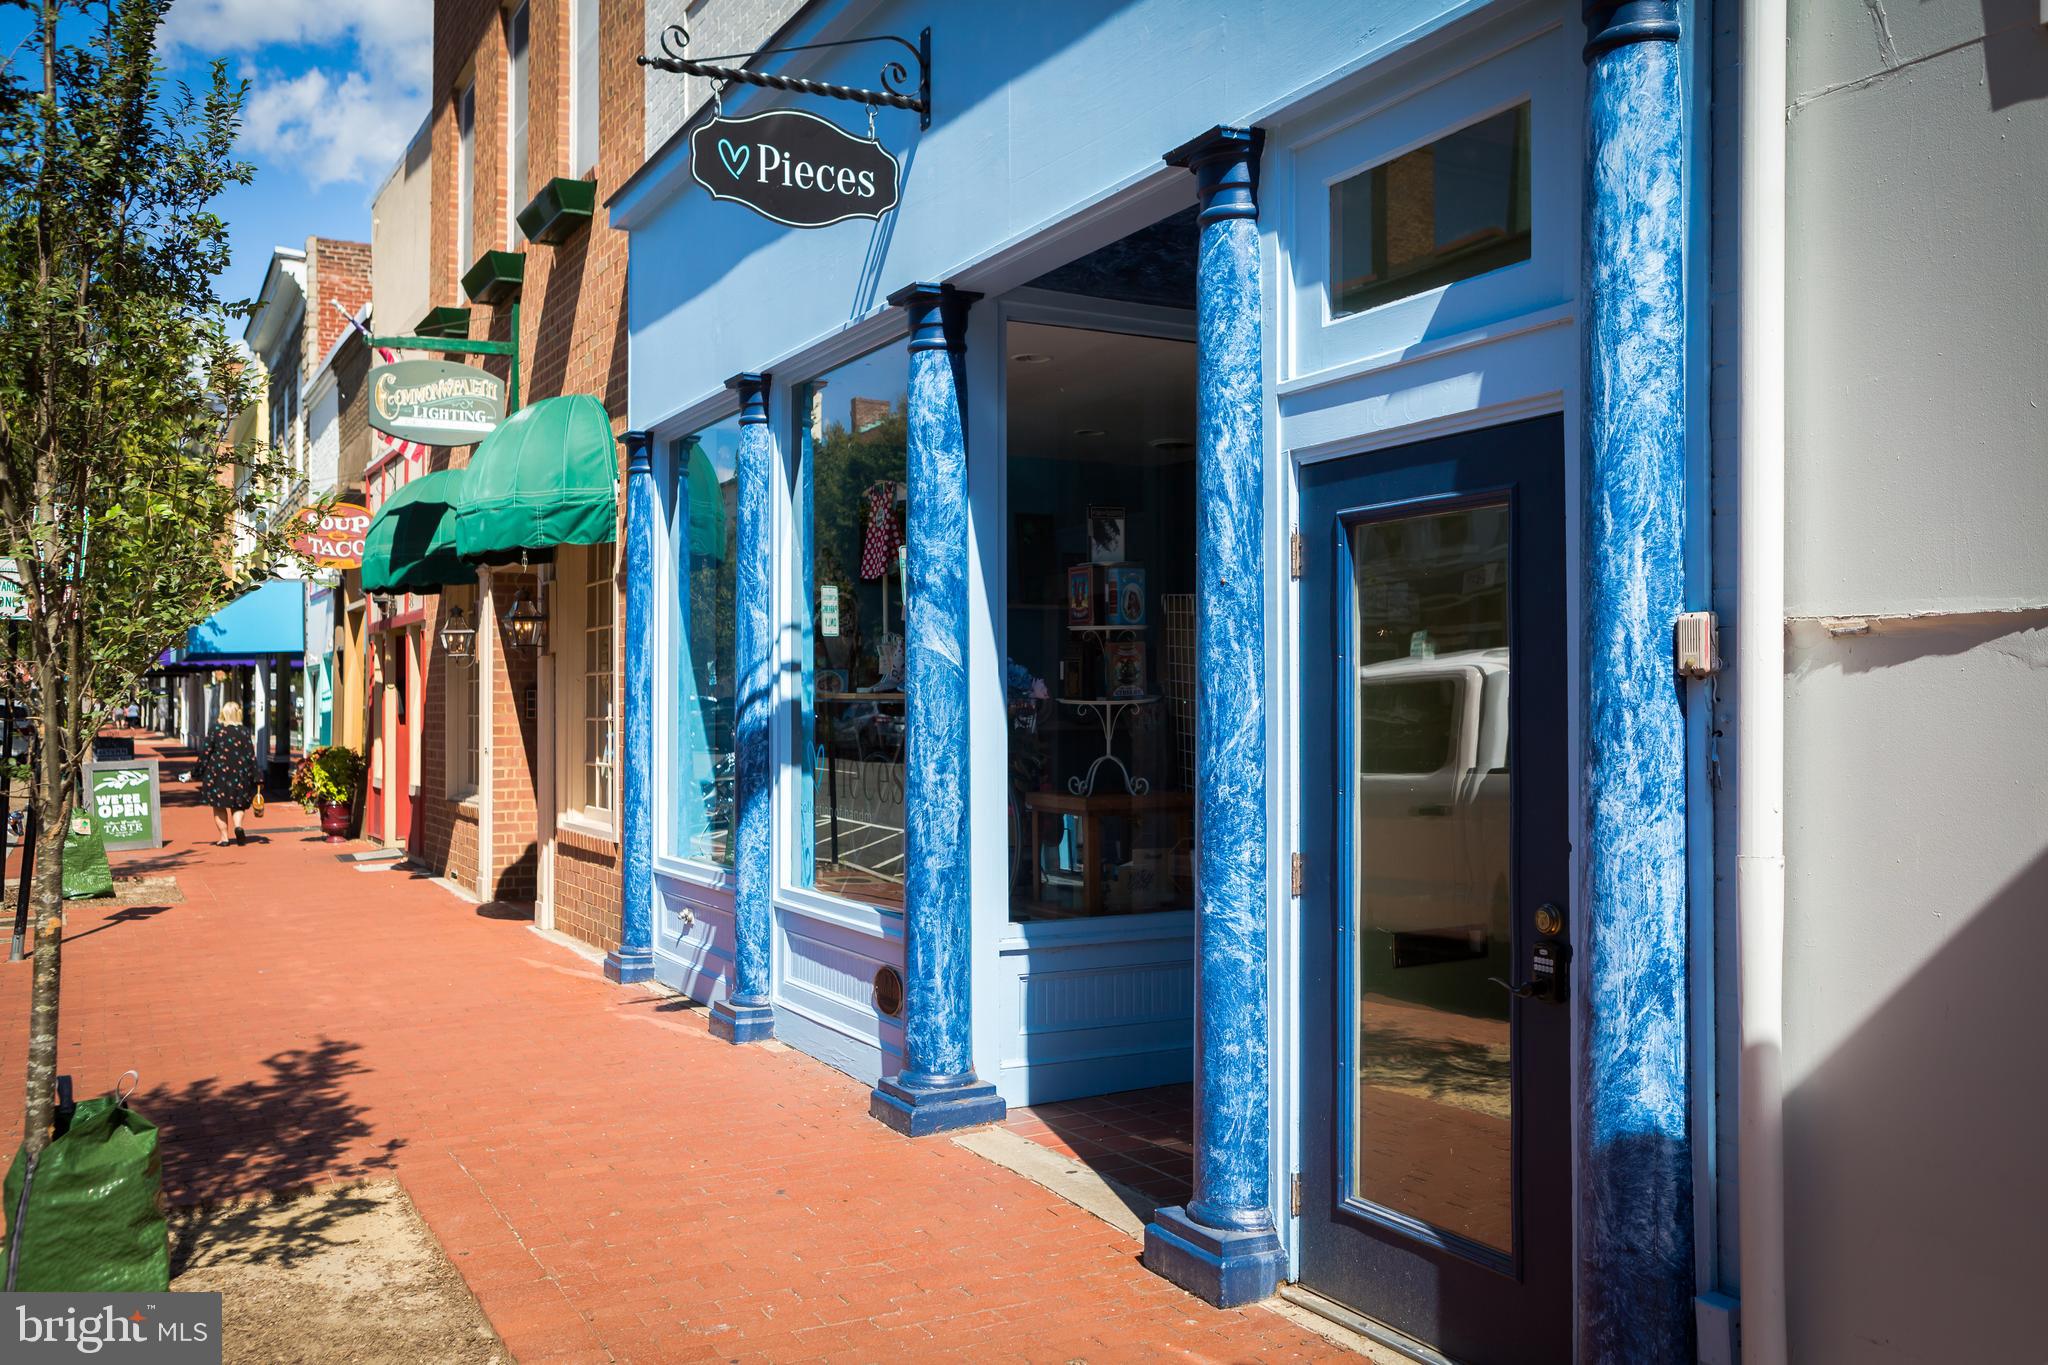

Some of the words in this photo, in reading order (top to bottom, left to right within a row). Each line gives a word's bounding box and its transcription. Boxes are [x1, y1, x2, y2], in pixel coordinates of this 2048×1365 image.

[757, 143, 876, 198] Pieces
[413, 404, 486, 423] LIGHTING
[308, 512, 370, 533] SOUP
[96, 793, 141, 806] WE'RE
[98, 802, 148, 818] OPEN
[103, 822, 143, 834] TASTE
